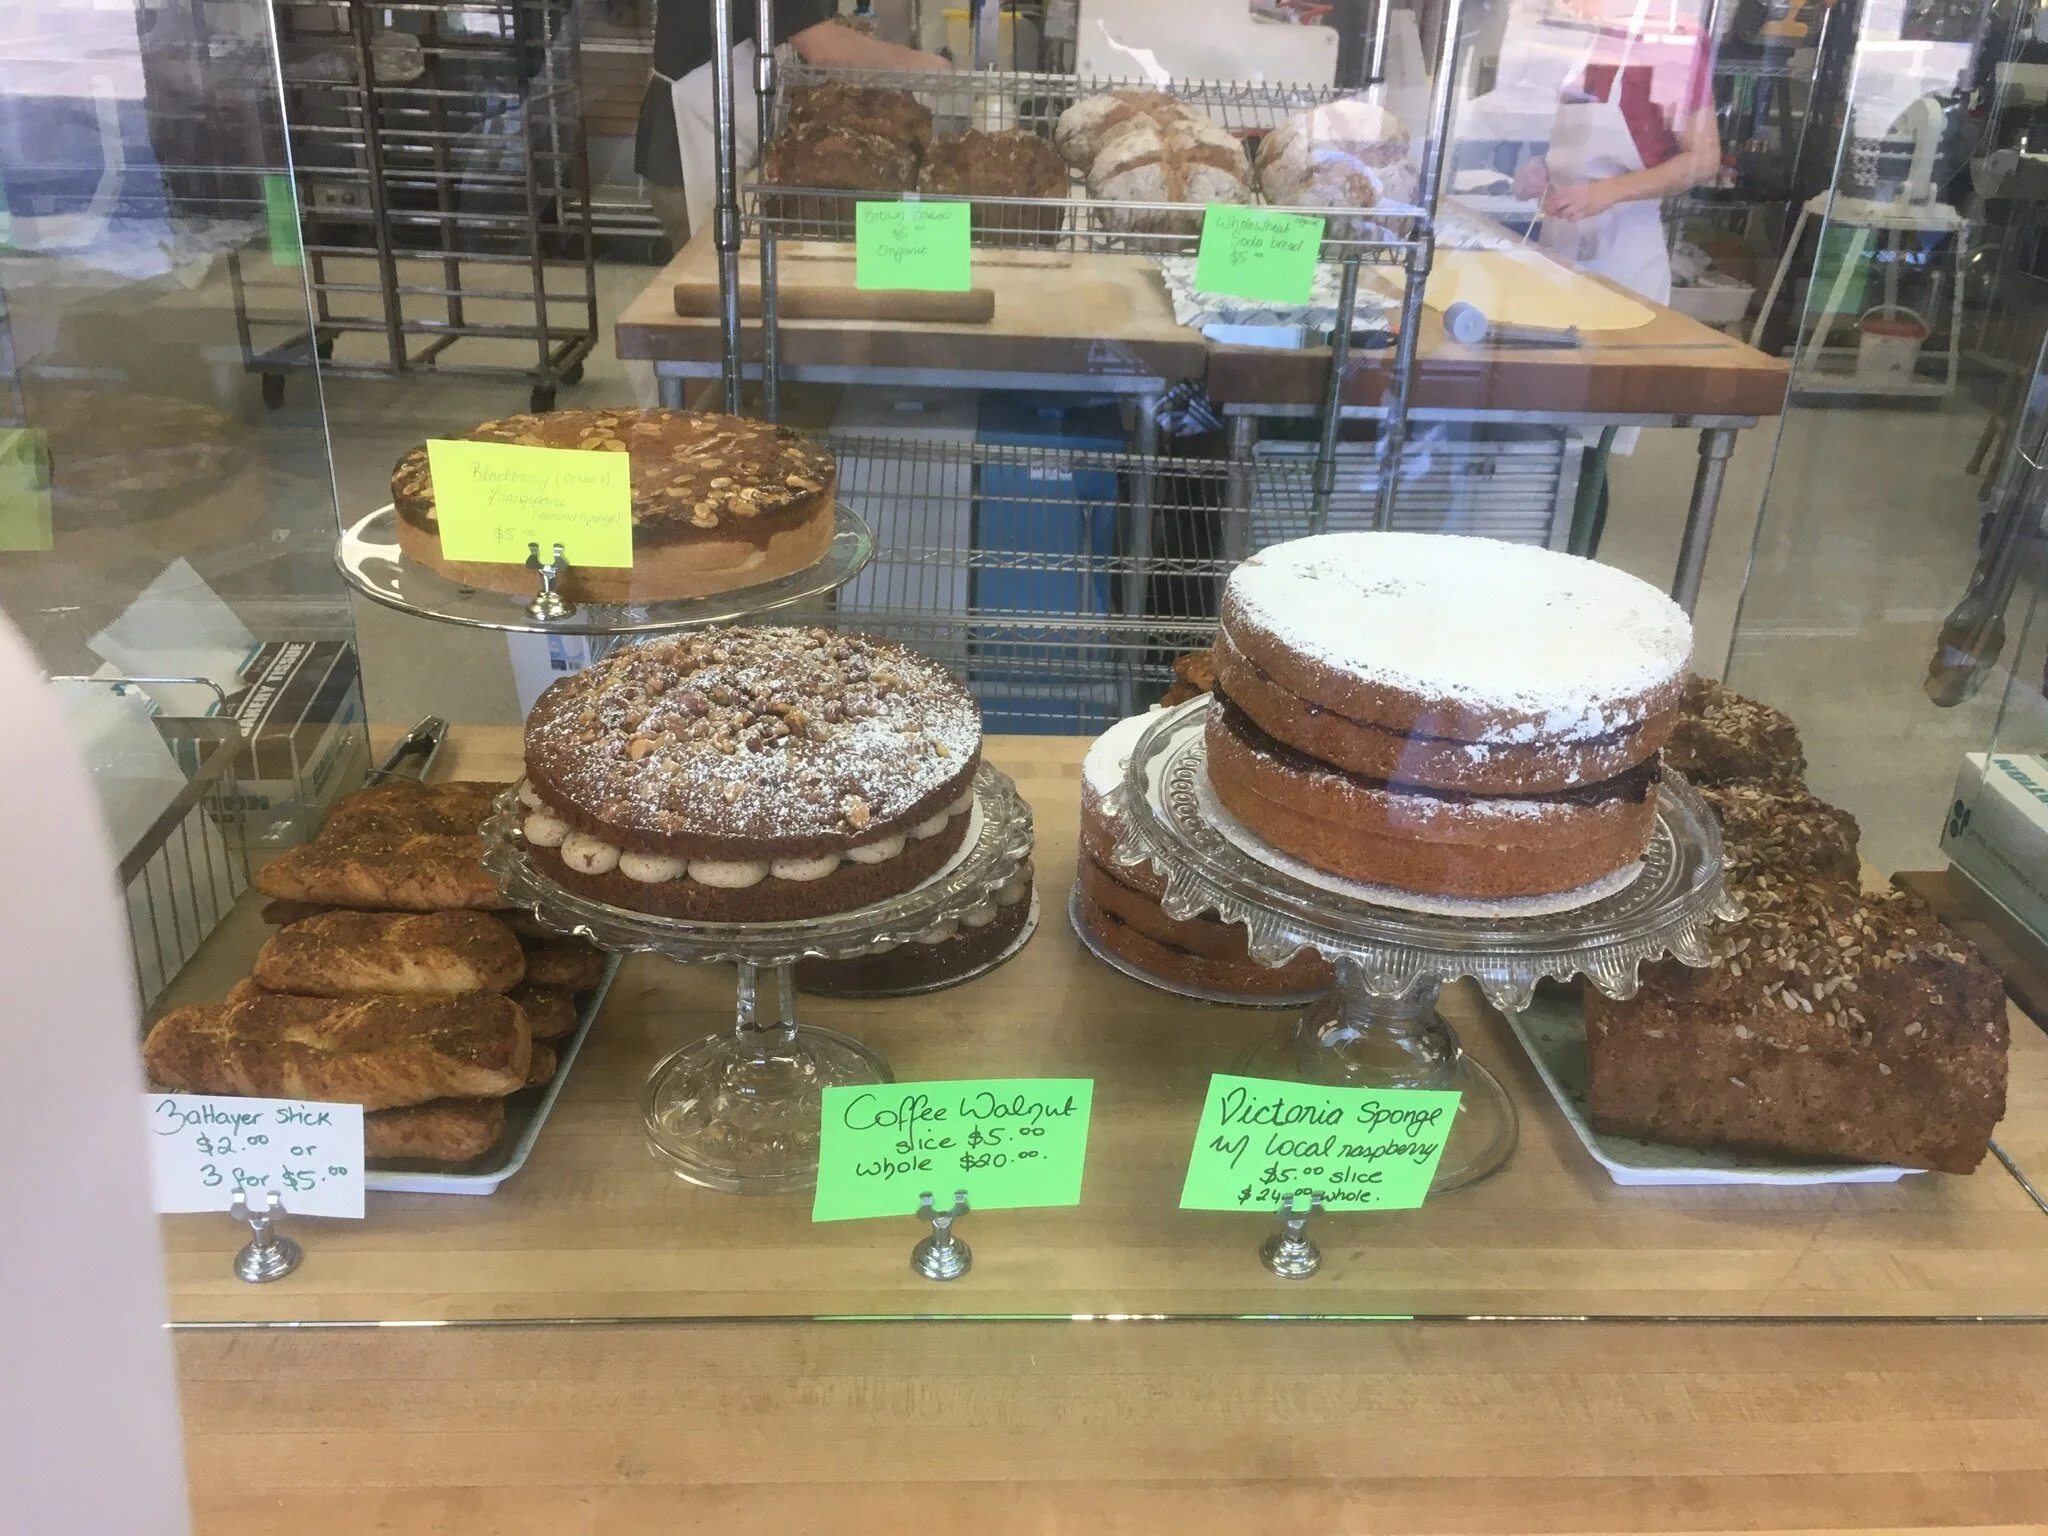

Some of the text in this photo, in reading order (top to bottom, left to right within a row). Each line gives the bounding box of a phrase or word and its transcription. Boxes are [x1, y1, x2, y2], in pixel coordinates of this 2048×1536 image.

[266, 644, 305, 682] TISSUE
[844, 1092, 1077, 1133] Coffee Walnut
[1221, 1086, 1443, 1137] Victoria Sponge
[291, 1146, 317, 1156] or
[896, 1126, 956, 1154] slice
[1336, 1139, 1438, 1164] raspberry
[200, 1164, 223, 1186] 3
[232, 1168, 270, 1189] for
[856, 1155, 933, 1181] whole
[1329, 1165, 1383, 1183] slice
